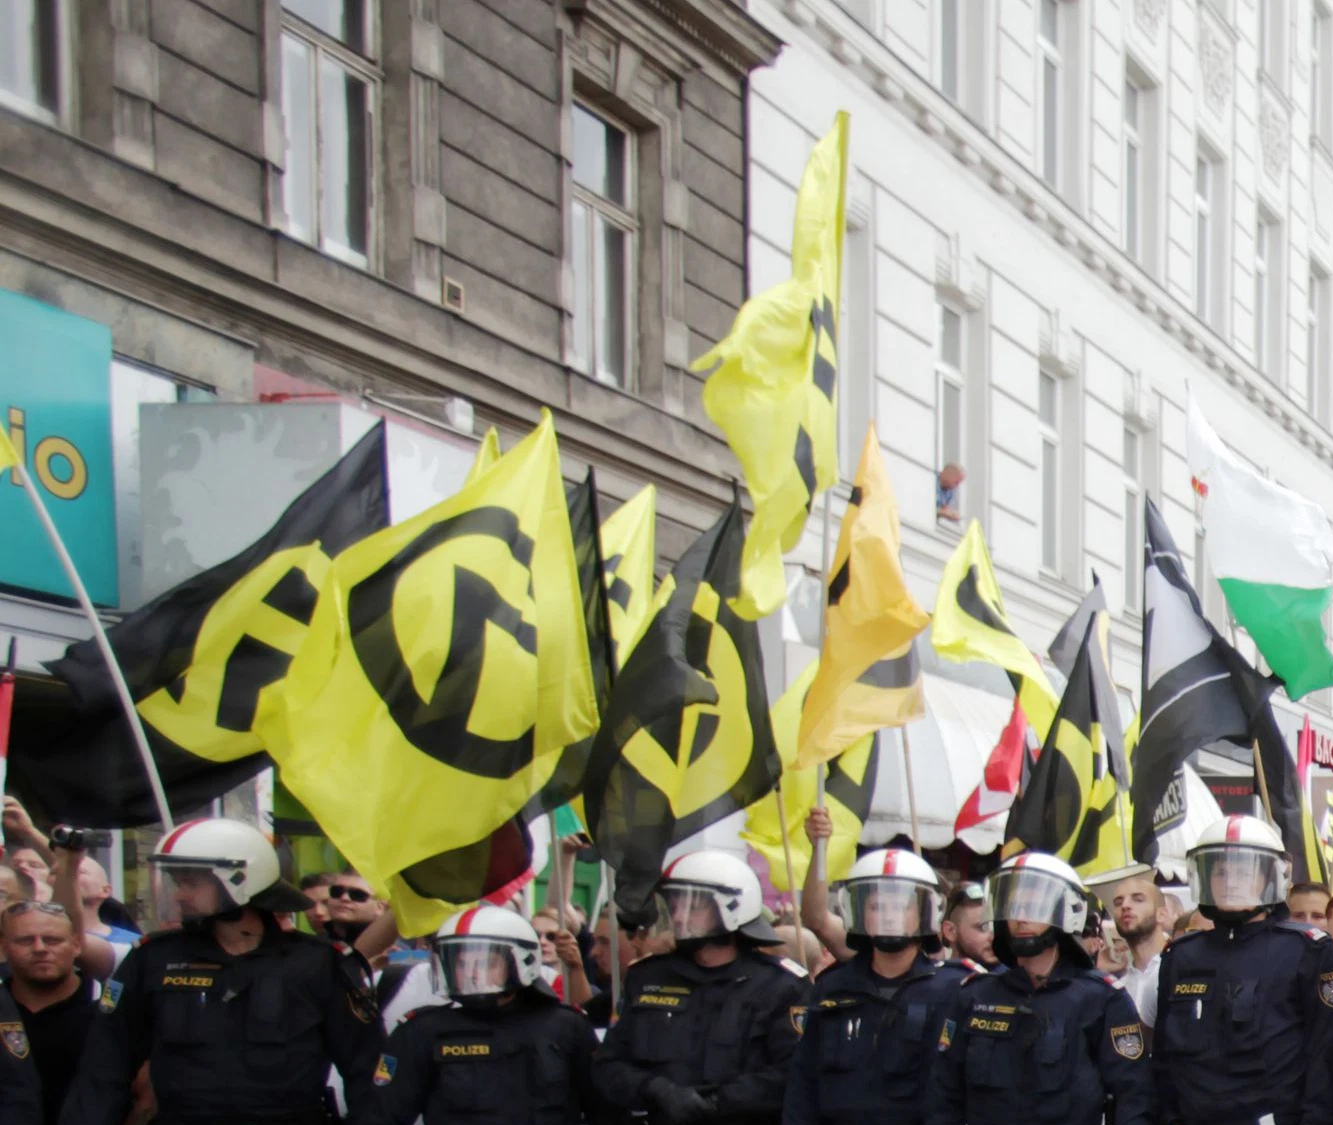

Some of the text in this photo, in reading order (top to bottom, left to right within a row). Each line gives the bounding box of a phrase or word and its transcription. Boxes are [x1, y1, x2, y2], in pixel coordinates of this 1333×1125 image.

[162, 976, 213, 988] POLIZEI
[1175, 983, 1208, 995] POLIZEI
[971, 1016, 1010, 1032] POLIZEI
[441, 1044, 491, 1056] POLIZEI
